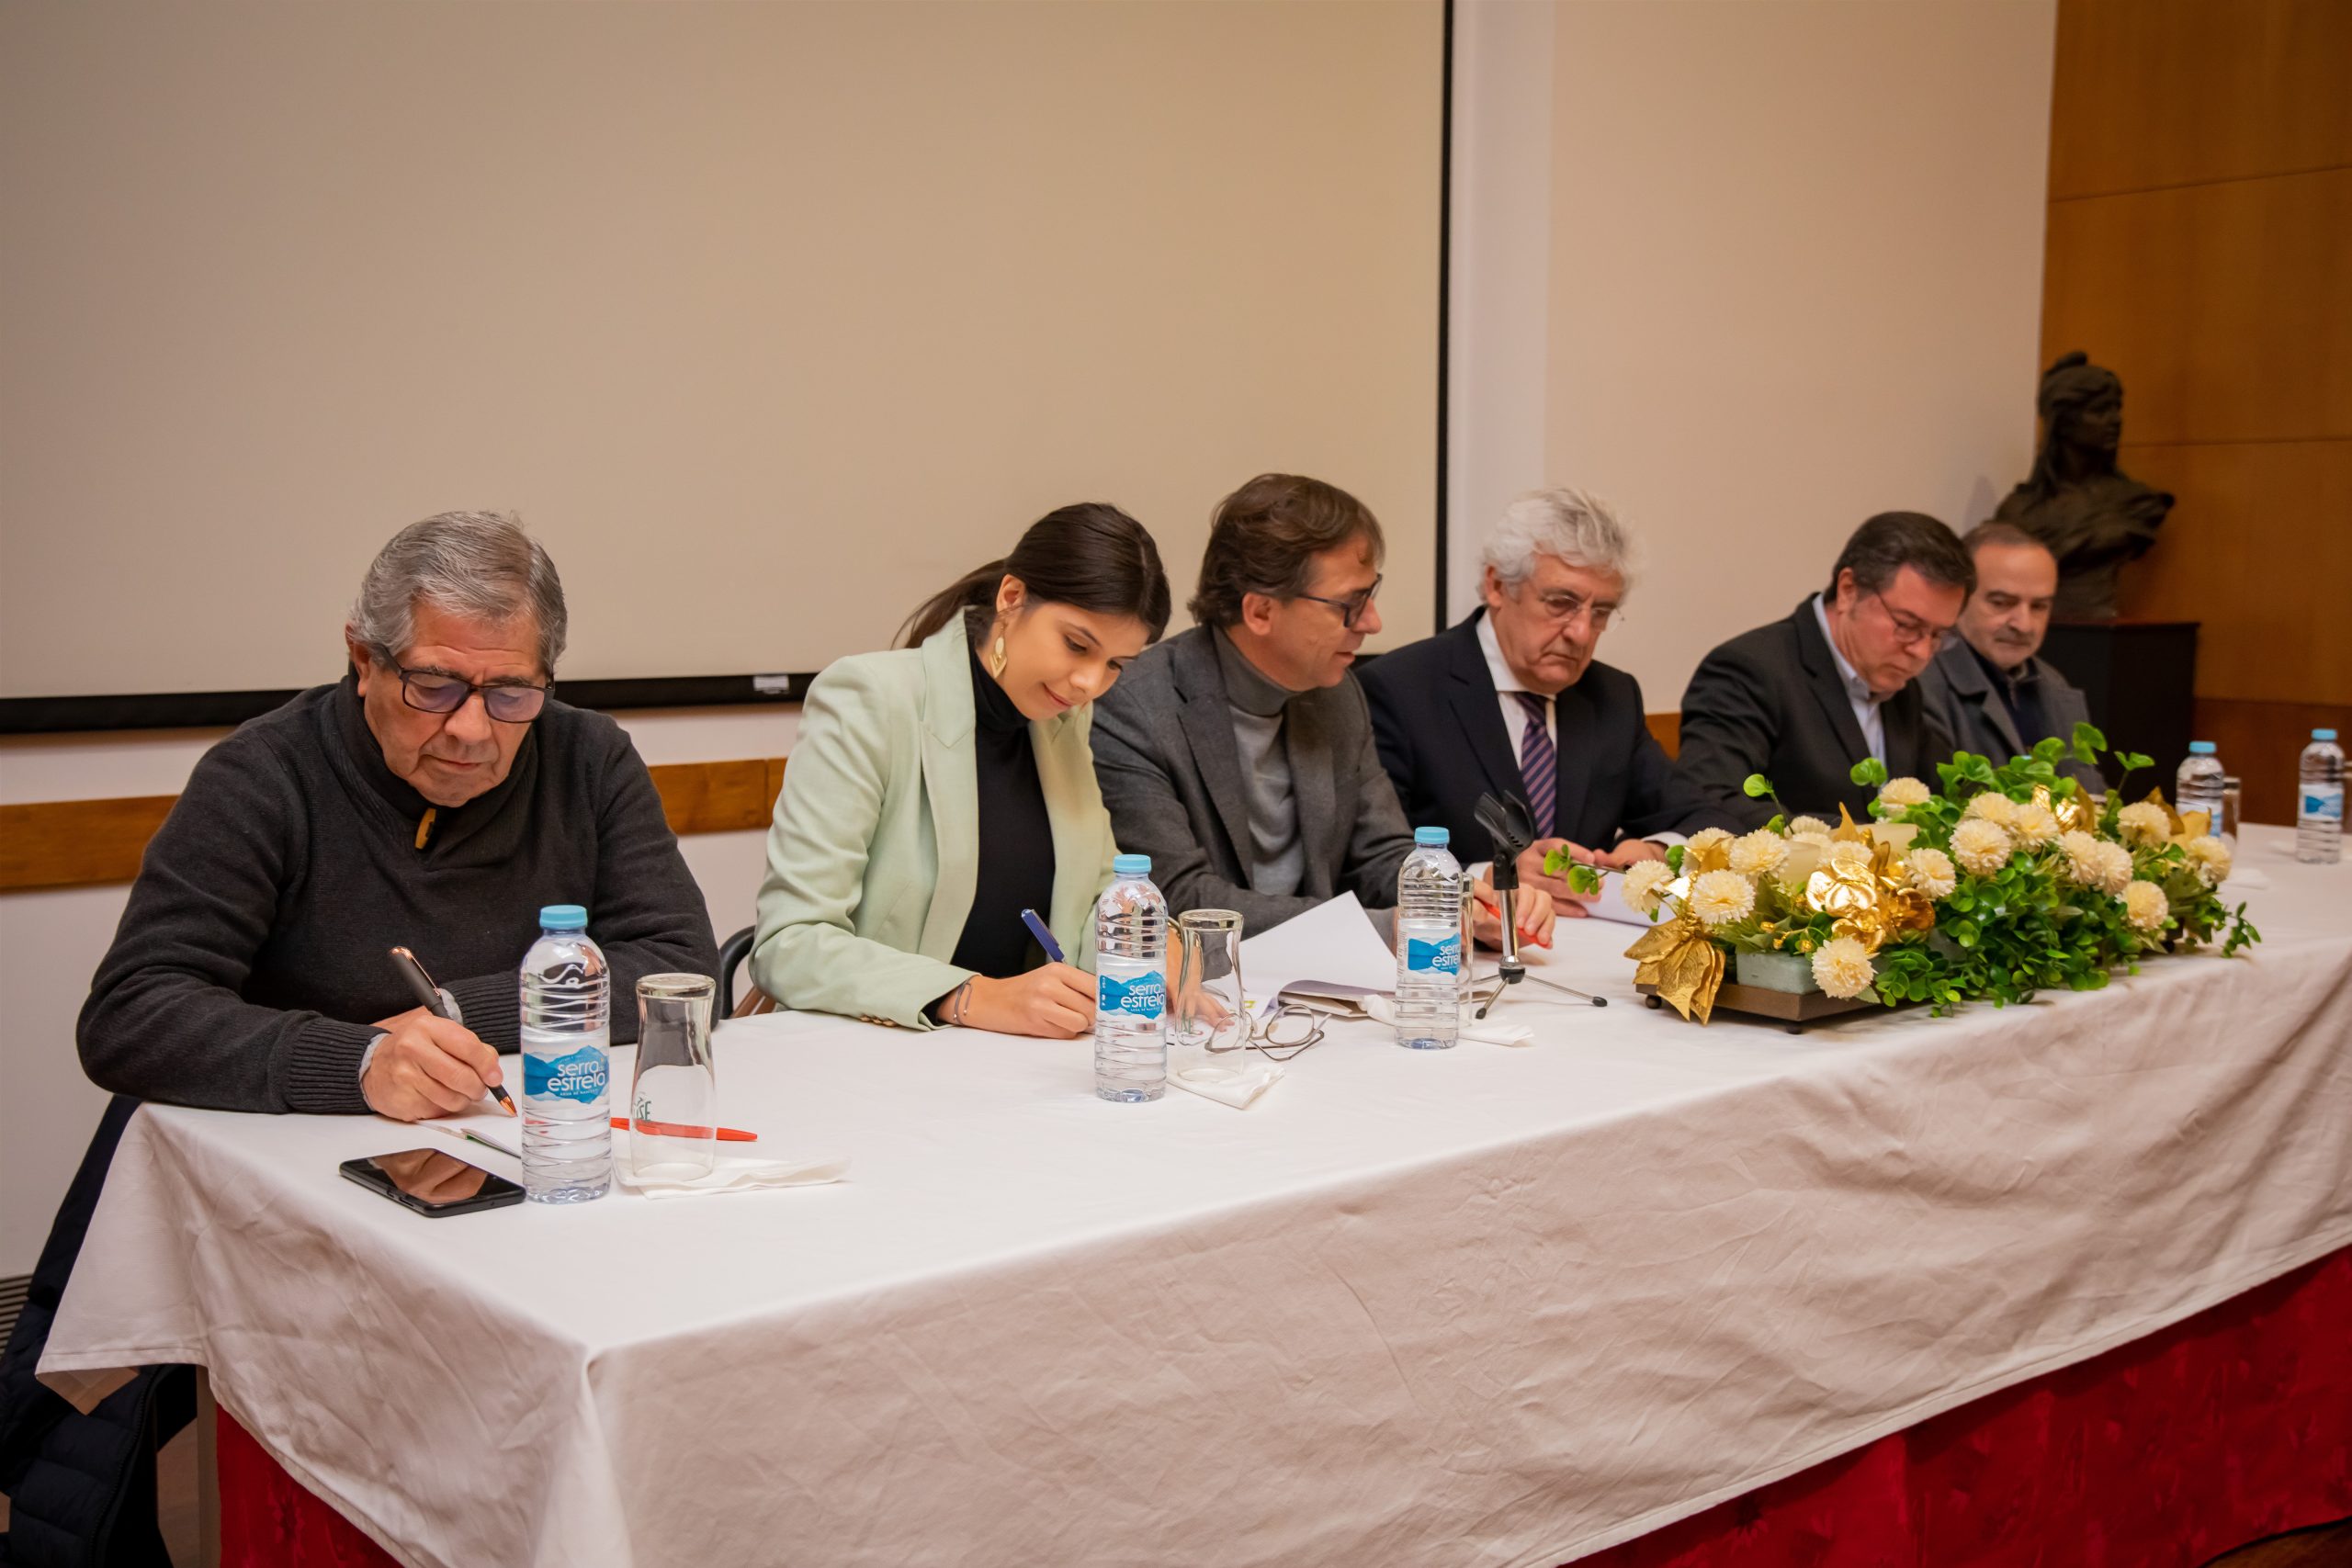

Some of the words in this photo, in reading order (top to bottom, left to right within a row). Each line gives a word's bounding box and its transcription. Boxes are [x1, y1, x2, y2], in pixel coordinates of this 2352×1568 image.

[1128, 983, 1161, 996] serra
[1120, 993, 1165, 1009] estrela
[557, 1060, 599, 1077] serra
[547, 1071, 605, 1092] estrela
